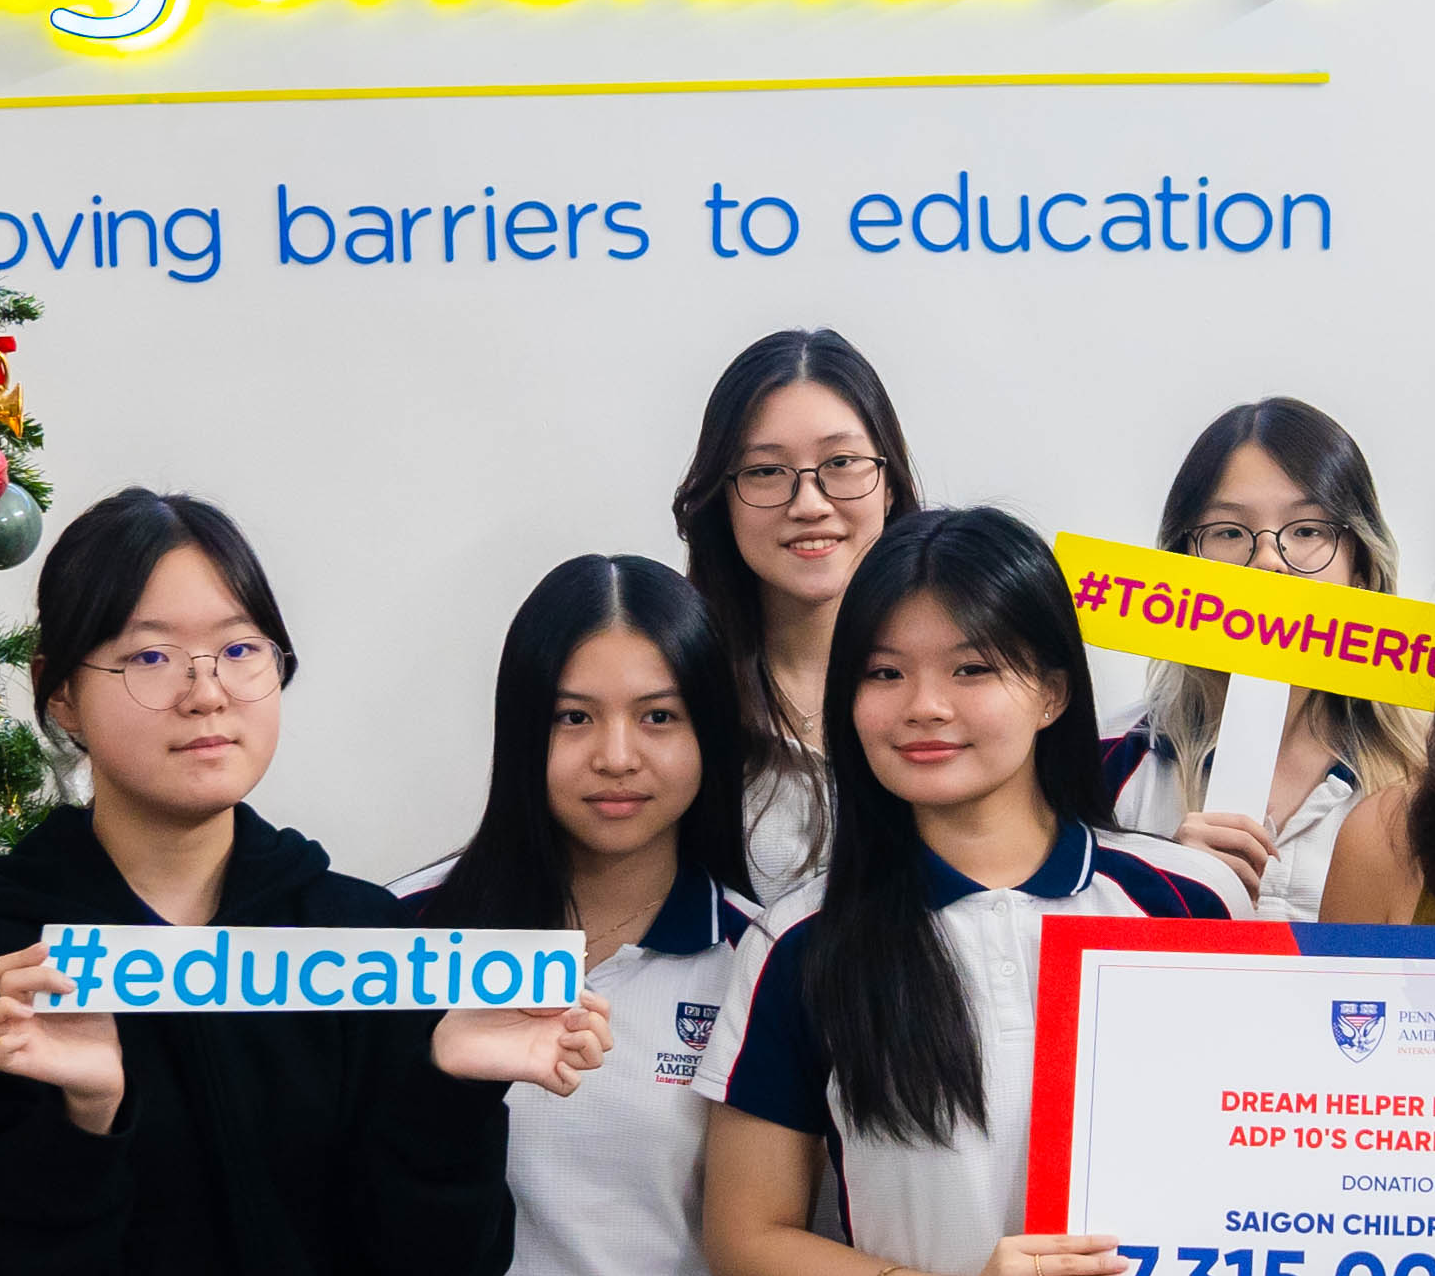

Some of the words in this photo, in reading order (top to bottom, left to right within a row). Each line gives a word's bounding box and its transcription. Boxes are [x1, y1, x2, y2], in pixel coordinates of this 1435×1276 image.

[276, 183, 650, 266] barriers
[704, 181, 800, 259] to
[848, 170, 1332, 255] education
[48, 927, 576, 1007] #education
[1221, 1090, 1317, 1114] DREAM
[1326, 1093, 1424, 1117] HELPER
[1229, 1126, 1286, 1148] ADP
[1294, 1127, 1347, 1150] 10'S
[1225, 1210, 1334, 1235] SAIGON
